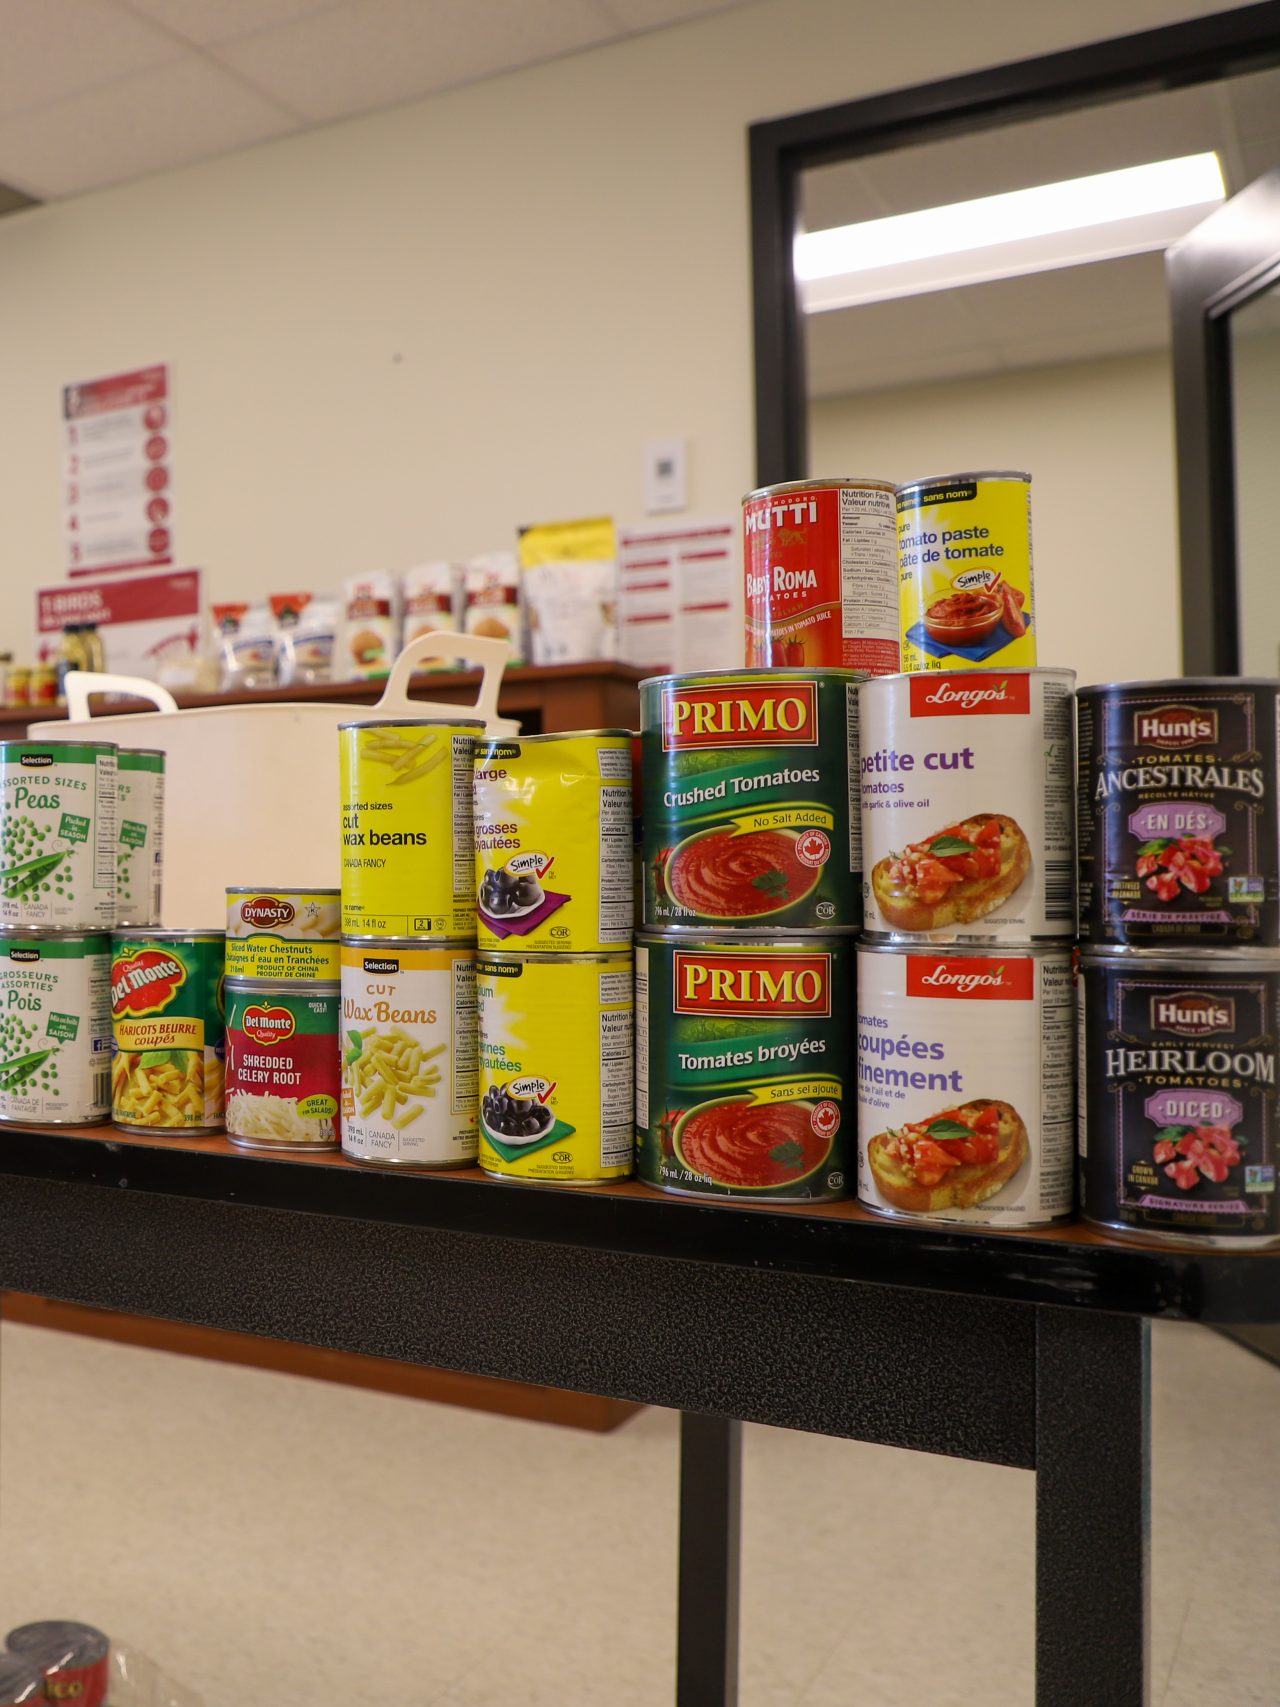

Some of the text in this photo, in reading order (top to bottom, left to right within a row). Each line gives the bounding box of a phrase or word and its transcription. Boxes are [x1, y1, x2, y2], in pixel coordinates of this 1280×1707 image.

[842, 490, 874, 498] Nutrition
[923, 490, 968, 502] sans nom
[842, 498, 866, 506] Valeur
[746, 501, 817, 535] MUTTI
[898, 522, 911, 534] pure
[899, 526, 990, 550] tomato paste
[899, 543, 1004, 569] pâte de tomate
[900, 571, 913, 582] pure
[957, 570, 992, 588] Simple
[795, 617, 816, 631] TOMATO
[816, 610, 832, 623] JUICE
[931, 659, 942, 669] liq
[671, 697, 808, 736] PRIMO
[1141, 716, 1213, 738] Hunt's
[861, 747, 975, 779] petite cut
[1137, 754, 1216, 765] TOMATES
[0, 776, 87, 791] SSORTED SIZES
[664, 768, 820, 807] Crushed Tomatoes
[1094, 765, 1265, 800] ANCESTRALES
[15, 786, 61, 810] Peas
[602, 789, 626, 797] Nutrition
[343, 801, 393, 811] assorted sizes
[602, 800, 622, 808] Valeur
[868, 798, 930, 811] garlic & olive oil
[343, 813, 359, 829] cut
[753, 812, 827, 829] No Salt Added
[1147, 810, 1207, 830] EN DÉS
[60, 829, 87, 840] SEASON
[475, 823, 518, 838] grosses
[343, 829, 427, 846] wax beans
[363, 858, 387, 868] FANCY
[510, 854, 543, 872] Simple
[24, 903, 49, 911] CANADA
[245, 908, 290, 918] DYNASTY
[348, 904, 362, 912] name
[674, 905, 682, 917] 28
[687, 908, 696, 917] oz
[362, 919, 370, 928] 14
[377, 920, 386, 928] oz
[10, 951, 39, 959] Selection
[247, 944, 267, 952] Water
[270, 944, 313, 954] Chestnuts
[287, 955, 330, 965] Tranchées
[364, 961, 397, 971] Selection
[484, 964, 515, 974] sans nom
[0, 970, 59, 983] GROSSEURS
[0, 980, 54, 992] ASSORTIES
[111, 960, 180, 1007] Del Monte
[683, 963, 823, 1004] PRIMO
[366, 984, 396, 996] CUT
[7, 989, 42, 1012] Pois
[343, 997, 437, 1025] Wax Beans
[1158, 1002, 1229, 1026] Hunt's
[245, 1015, 291, 1029] Del Monte
[602, 1014, 628, 1023] Nutrition
[48, 1028, 74, 1039] SAISON
[119, 1023, 197, 1036] HARICOTS BEURRE
[256, 1029, 276, 1039] Quality
[602, 1024, 623, 1032] Valeur
[134, 1034, 175, 1046] coupés
[1151, 1040, 1235, 1050] EARLY HARVEST
[858, 1033, 945, 1061] coupées
[678, 1037, 826, 1070] Tomates broyées
[243, 1054, 293, 1069] SHREDDED
[1105, 1047, 1275, 1084] HEIRLOOM
[238, 1068, 302, 1085] CELERY ROOT
[858, 1056, 963, 1092] finement
[512, 1079, 545, 1094] Simple
[1144, 1075, 1242, 1088] TOMATOES
[770, 1084, 838, 1099] Sans sel ajouté
[885, 1089, 893, 1097] et
[894, 1090, 906, 1099] de
[306, 1098, 328, 1106] GREAT
[1166, 1100, 1223, 1119] DICED
[355, 1128, 364, 1136] mL
[369, 1130, 396, 1141] CANADA
[371, 1140, 393, 1149] FANCY
[659, 1165, 712, 1185] 796 mL 28 oz liq
[1132, 1165, 1154, 1176] GROWN
[1135, 1175, 1159, 1186] CANADA
[1149, 1198, 1205, 1210] SIGNATURE
